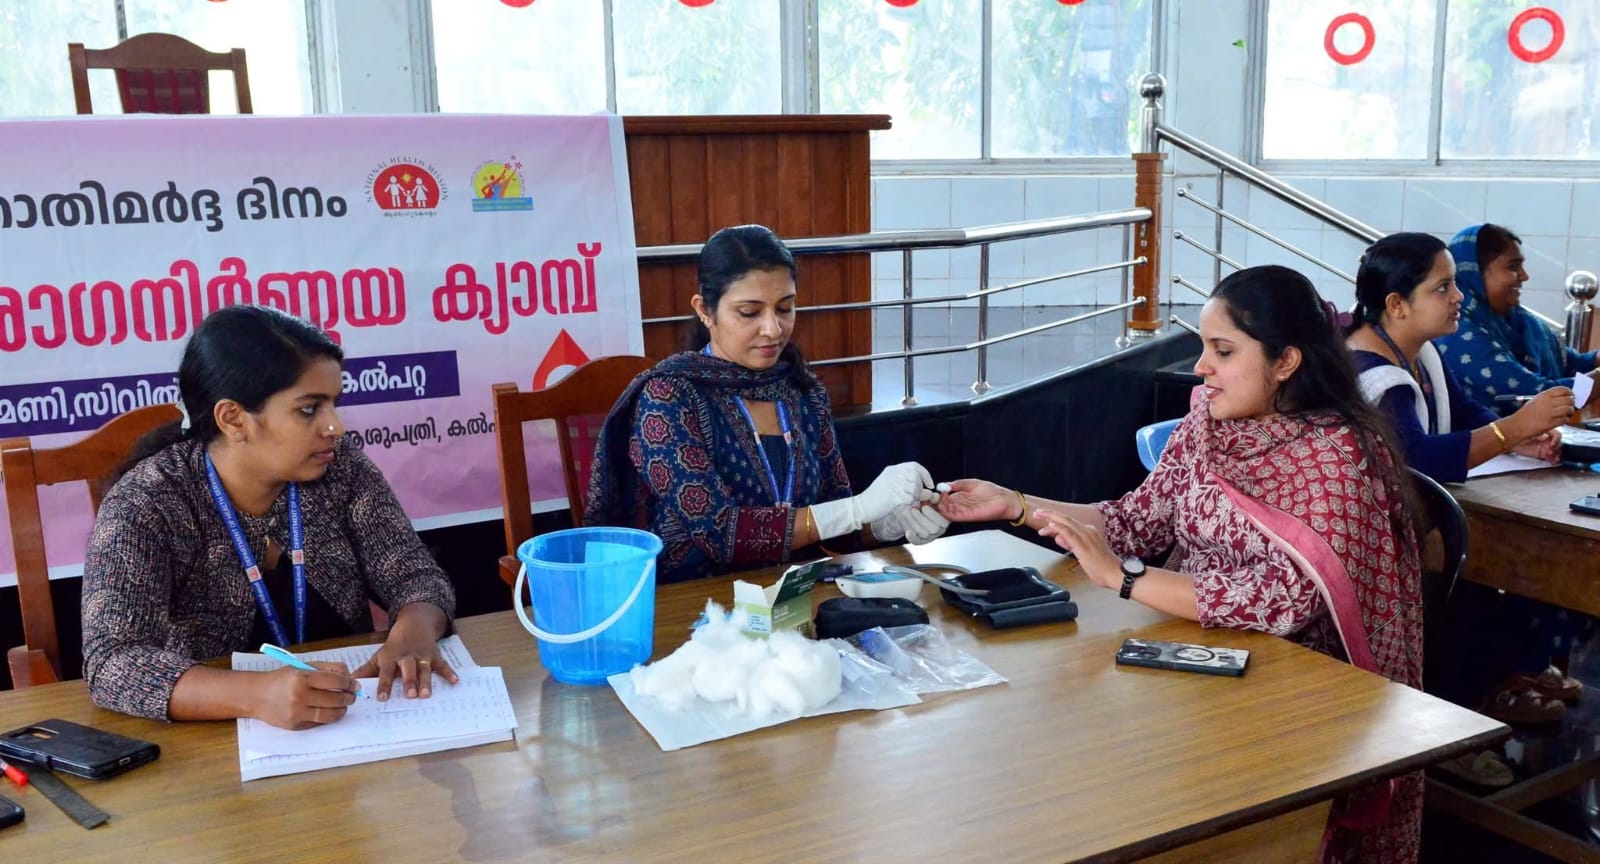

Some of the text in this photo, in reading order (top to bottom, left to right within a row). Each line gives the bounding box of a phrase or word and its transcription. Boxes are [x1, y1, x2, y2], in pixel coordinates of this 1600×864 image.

[237, 176, 347, 220] ദിനം
[432, 242, 602, 335] ക്യാമ്പ്
[290, 509, 300, 549] DEPARTMENT
